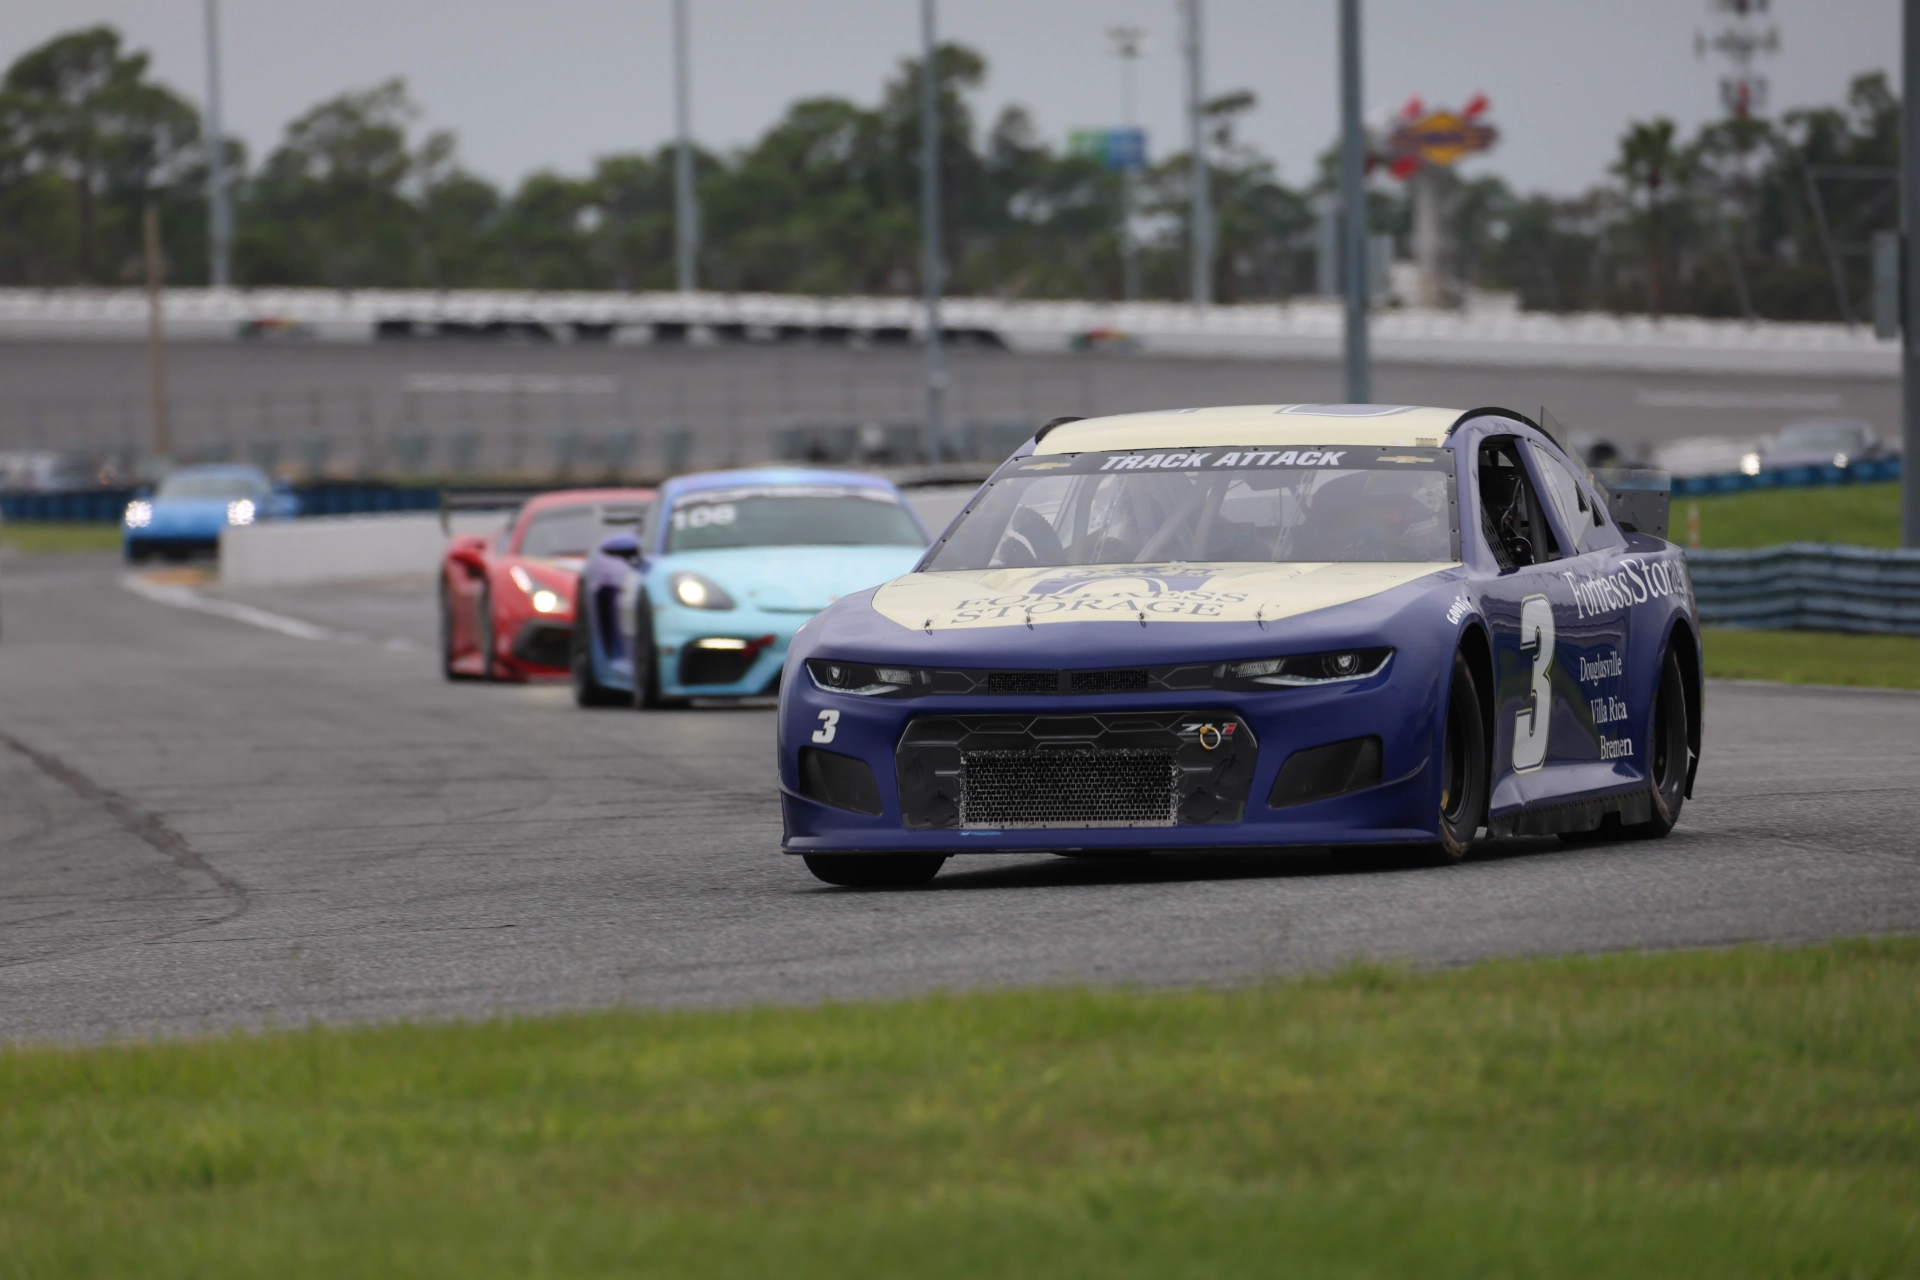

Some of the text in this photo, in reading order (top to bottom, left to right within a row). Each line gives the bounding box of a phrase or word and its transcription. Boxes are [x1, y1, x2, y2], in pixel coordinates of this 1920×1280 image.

[1100, 451, 1347, 471] TRACK ATTACK
[951, 599, 1225, 624] STORAGE
[1511, 592, 1556, 775] 3
[1580, 650, 1622, 687] Douglasville
[1590, 695, 1628, 725] Villa Rica
[811, 709, 841, 744] 3
[1600, 735, 1634, 760] Bremen
